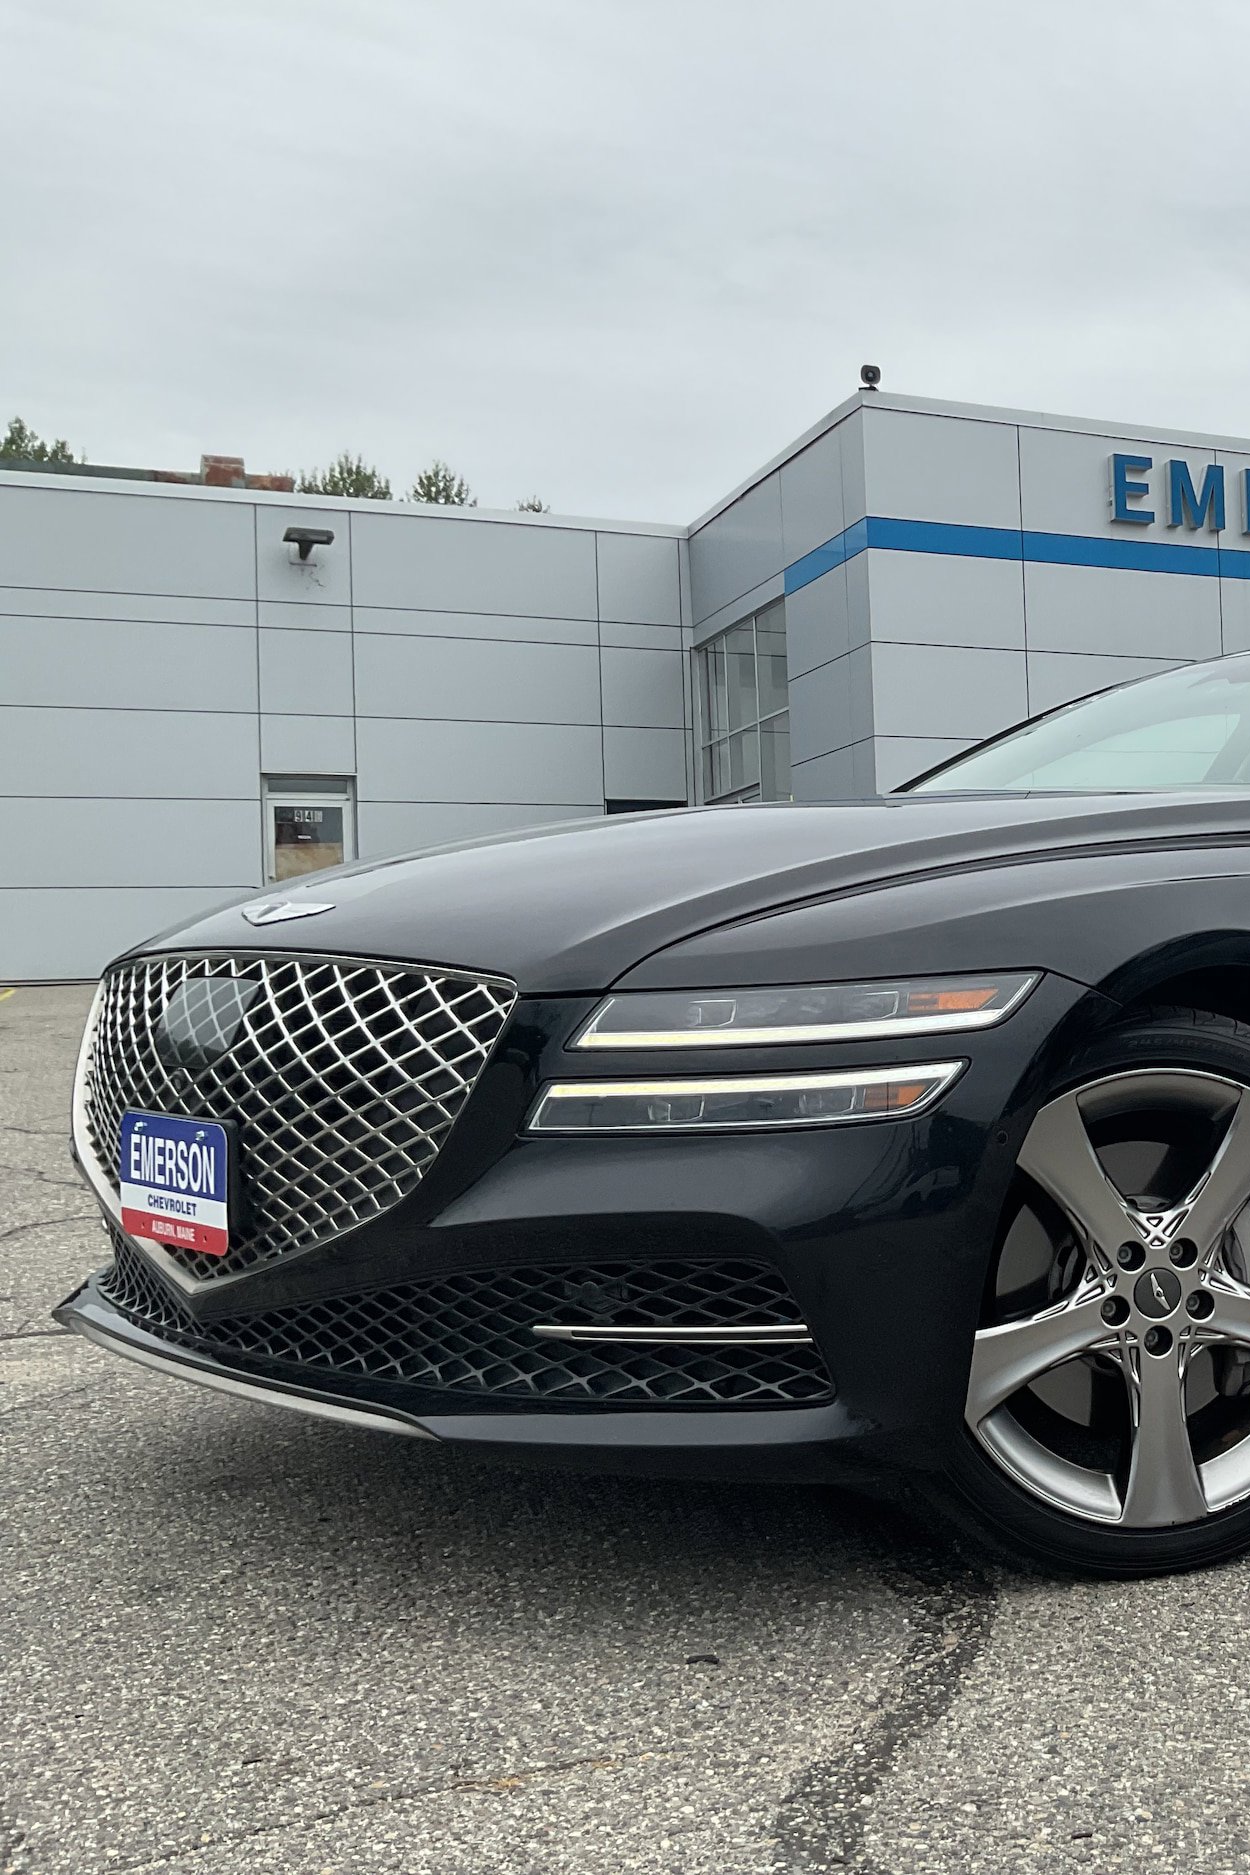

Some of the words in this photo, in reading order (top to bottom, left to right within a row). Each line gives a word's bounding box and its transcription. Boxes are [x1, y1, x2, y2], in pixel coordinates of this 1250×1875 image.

[130, 1133, 215, 1195] EMERSON
[148, 1195, 197, 1216] CHEVROLET
[176, 1225, 196, 1243] MAINE
